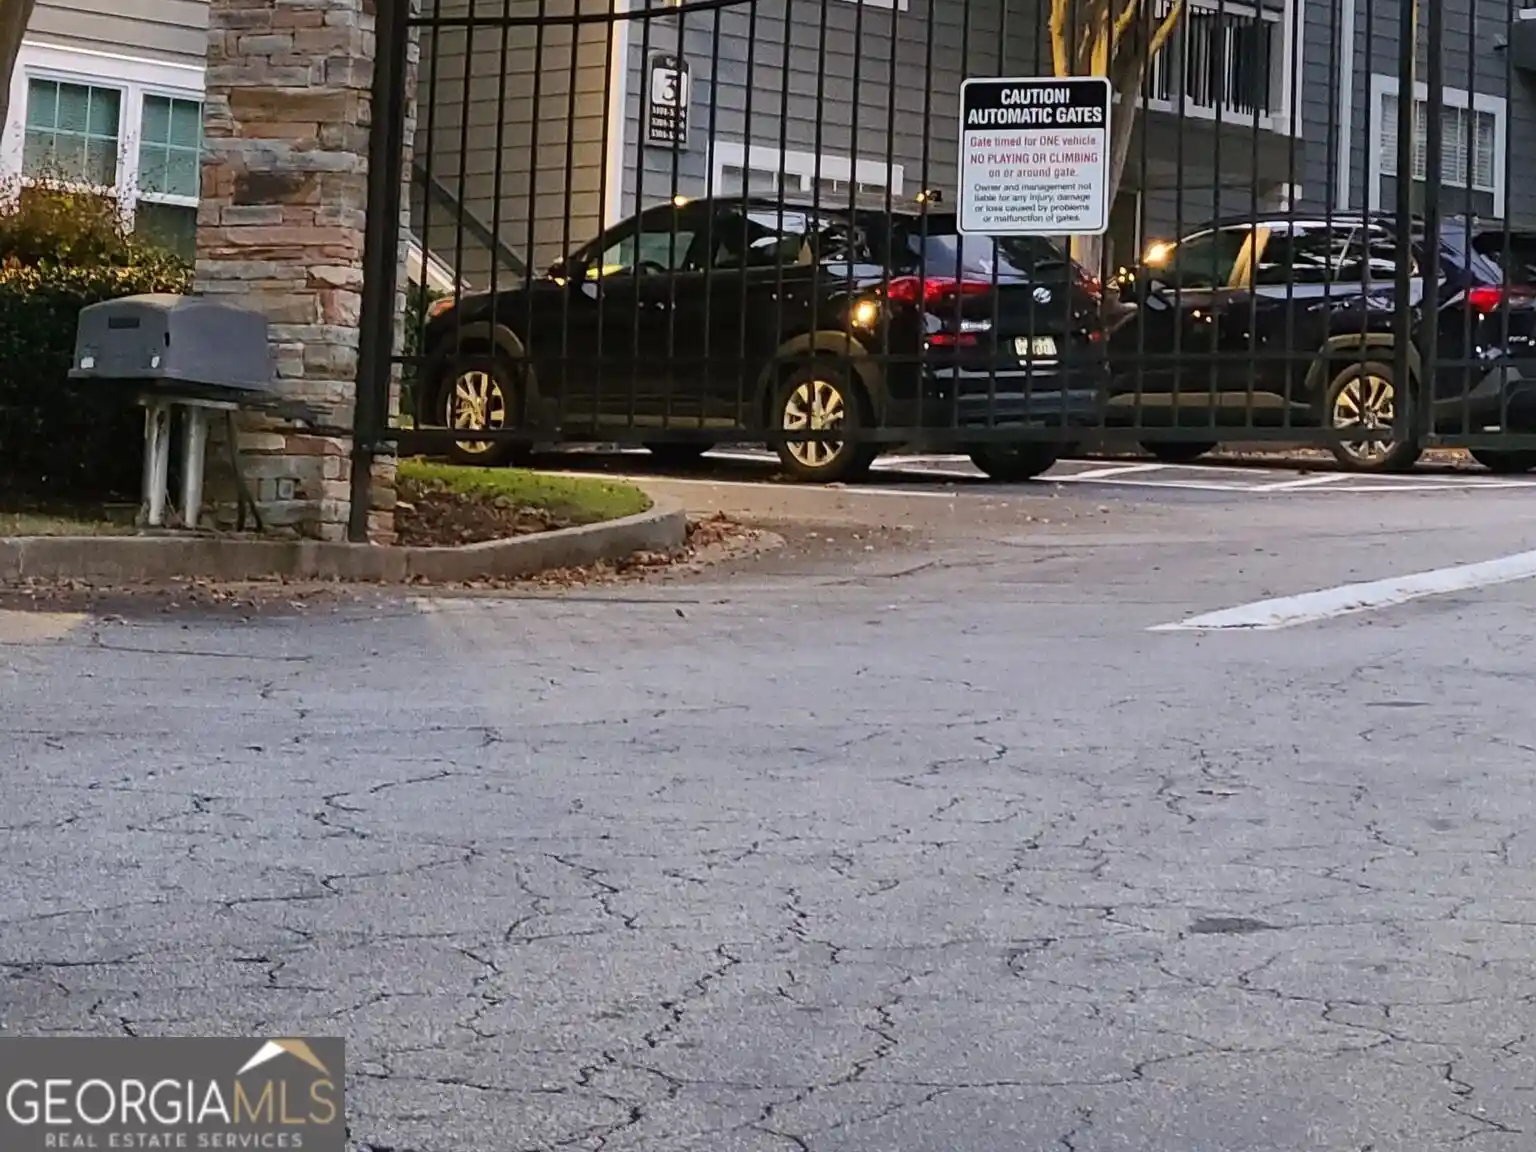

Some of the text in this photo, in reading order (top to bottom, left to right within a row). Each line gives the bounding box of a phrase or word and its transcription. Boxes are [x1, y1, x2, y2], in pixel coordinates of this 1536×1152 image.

[1001, 88, 1070, 104] CAUTION!
[968, 107, 1102, 124] AUTOMATIC GATES
[970, 137, 992, 148] Gate
[995, 136, 1021, 147] timed
[1024, 136, 1036, 146] for
[1040, 136, 1059, 146] ONE
[970, 152, 1098, 164] NO PLAYING OR CLIMBING
[989, 170, 1000, 178] on
[1004, 169, 1013, 177] or
[1017, 168, 1050, 177] around
[974, 183, 1001, 191] Owner
[1003, 183, 1019, 191] and
[1021, 183, 1075, 192] management
[1057, 194, 1090, 202] damage
[1005, 204, 1035, 212] caused
[1038, 204, 1047, 213] by
[1050, 204, 1089, 212] problems
